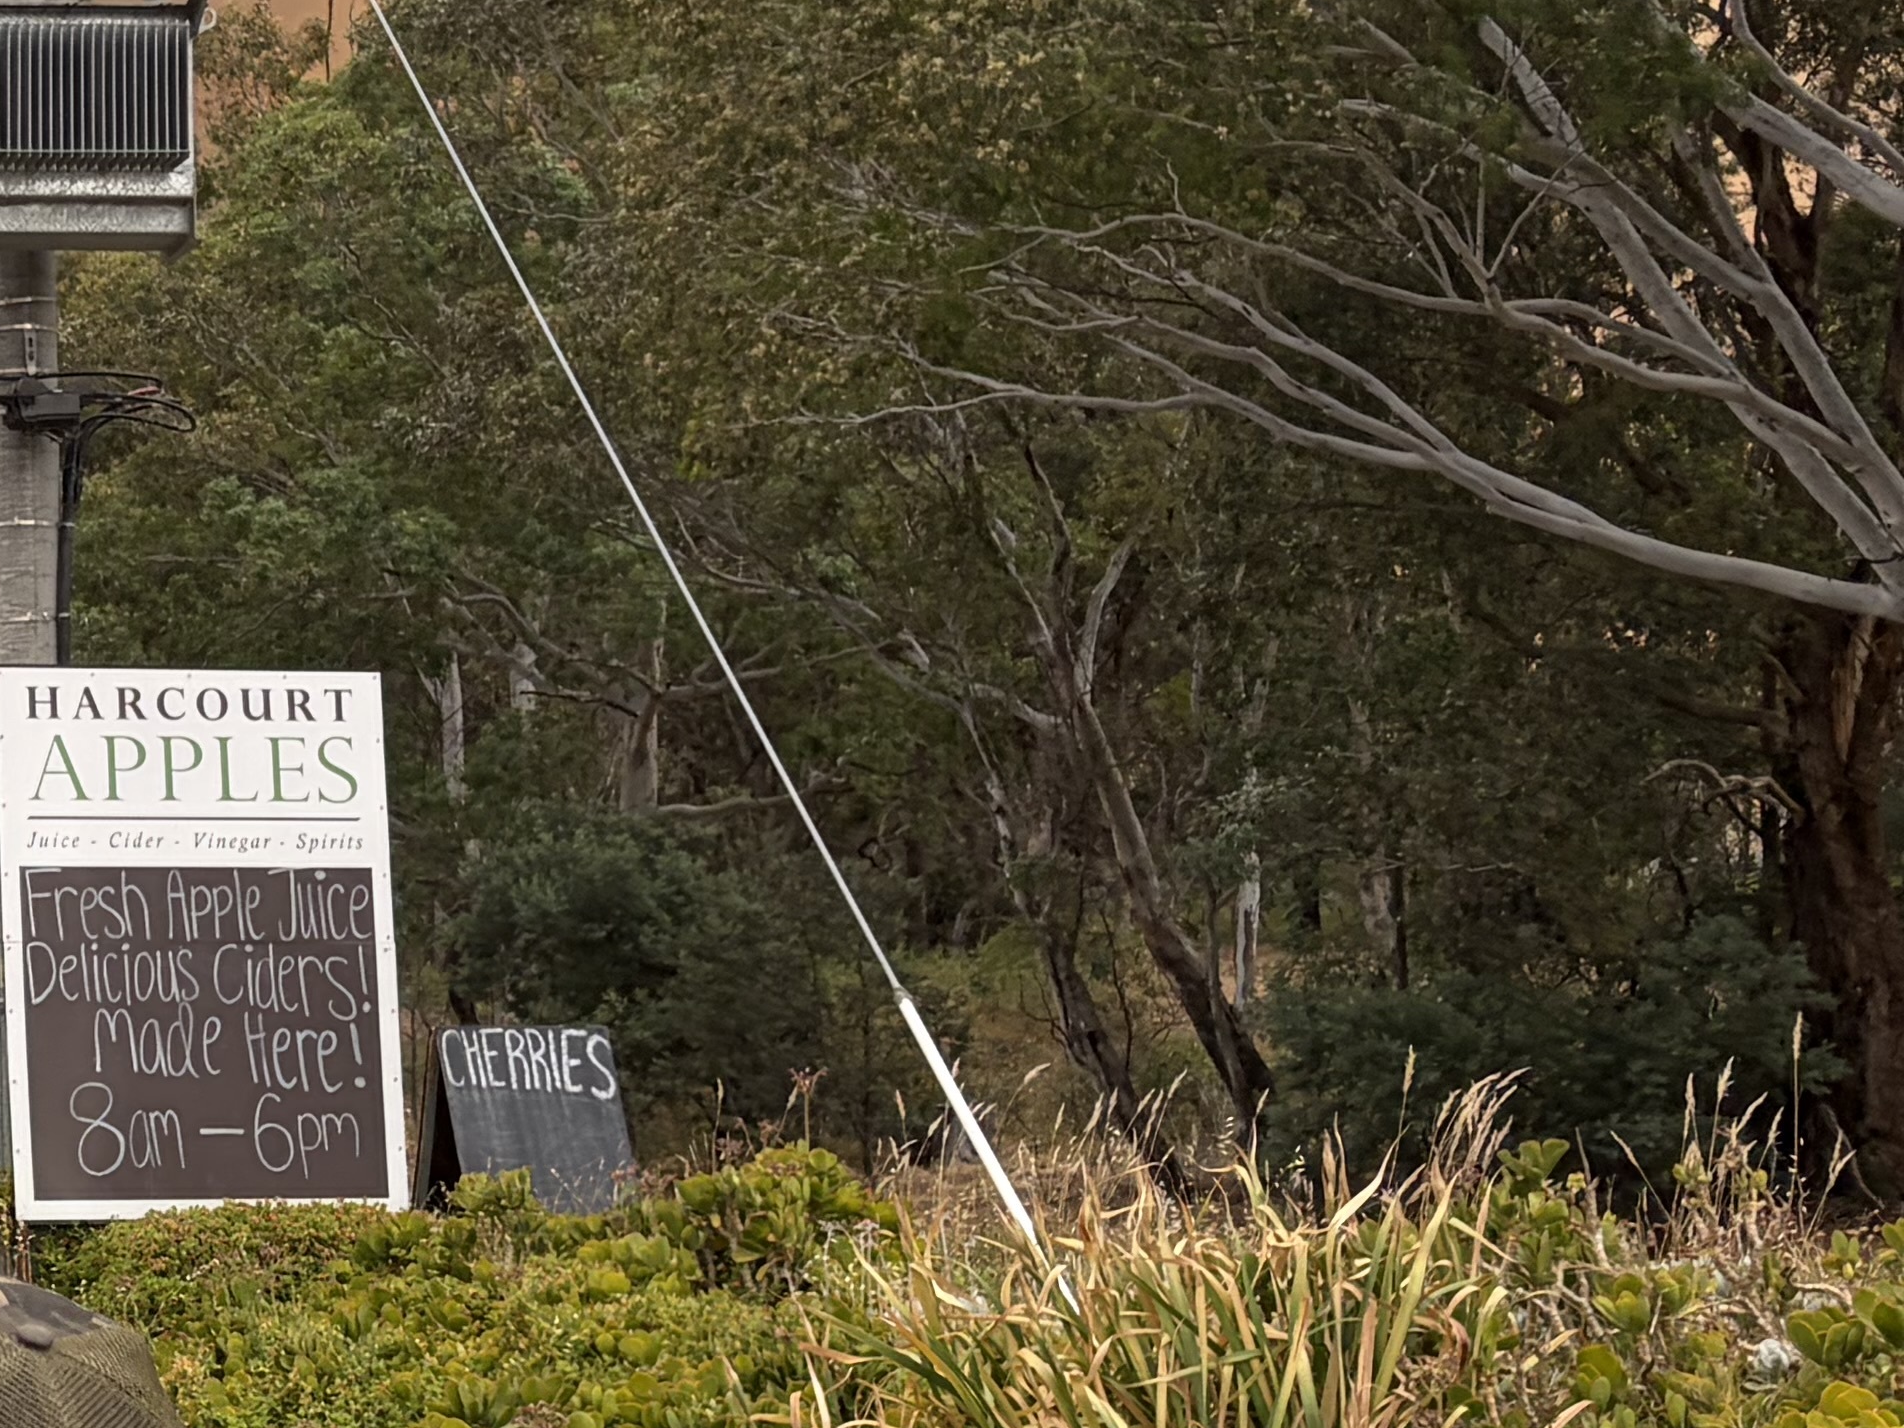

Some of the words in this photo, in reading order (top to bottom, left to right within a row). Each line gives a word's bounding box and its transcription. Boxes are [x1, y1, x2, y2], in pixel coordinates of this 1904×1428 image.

[25, 685, 353, 722] HARCOURT
[28, 734, 358, 804] APPLES
[26, 831, 81, 849] Juice
[108, 831, 164, 850] Cider
[192, 831, 272, 853] Vinegar
[295, 832, 365, 854] Spirits
[25, 869, 151, 942] Fresh
[167, 869, 265, 942] Apple
[267, 868, 373, 942] Juice
[26, 941, 200, 1006] Delicious
[213, 942, 373, 1021] Ciders!
[94, 1001, 222, 1079] Made
[244, 1011, 367, 1094] Here!
[442, 1028, 617, 1100] CHERRIES
[69, 1082, 185, 1176] 8am
[254, 1093, 360, 1180] 6pm
